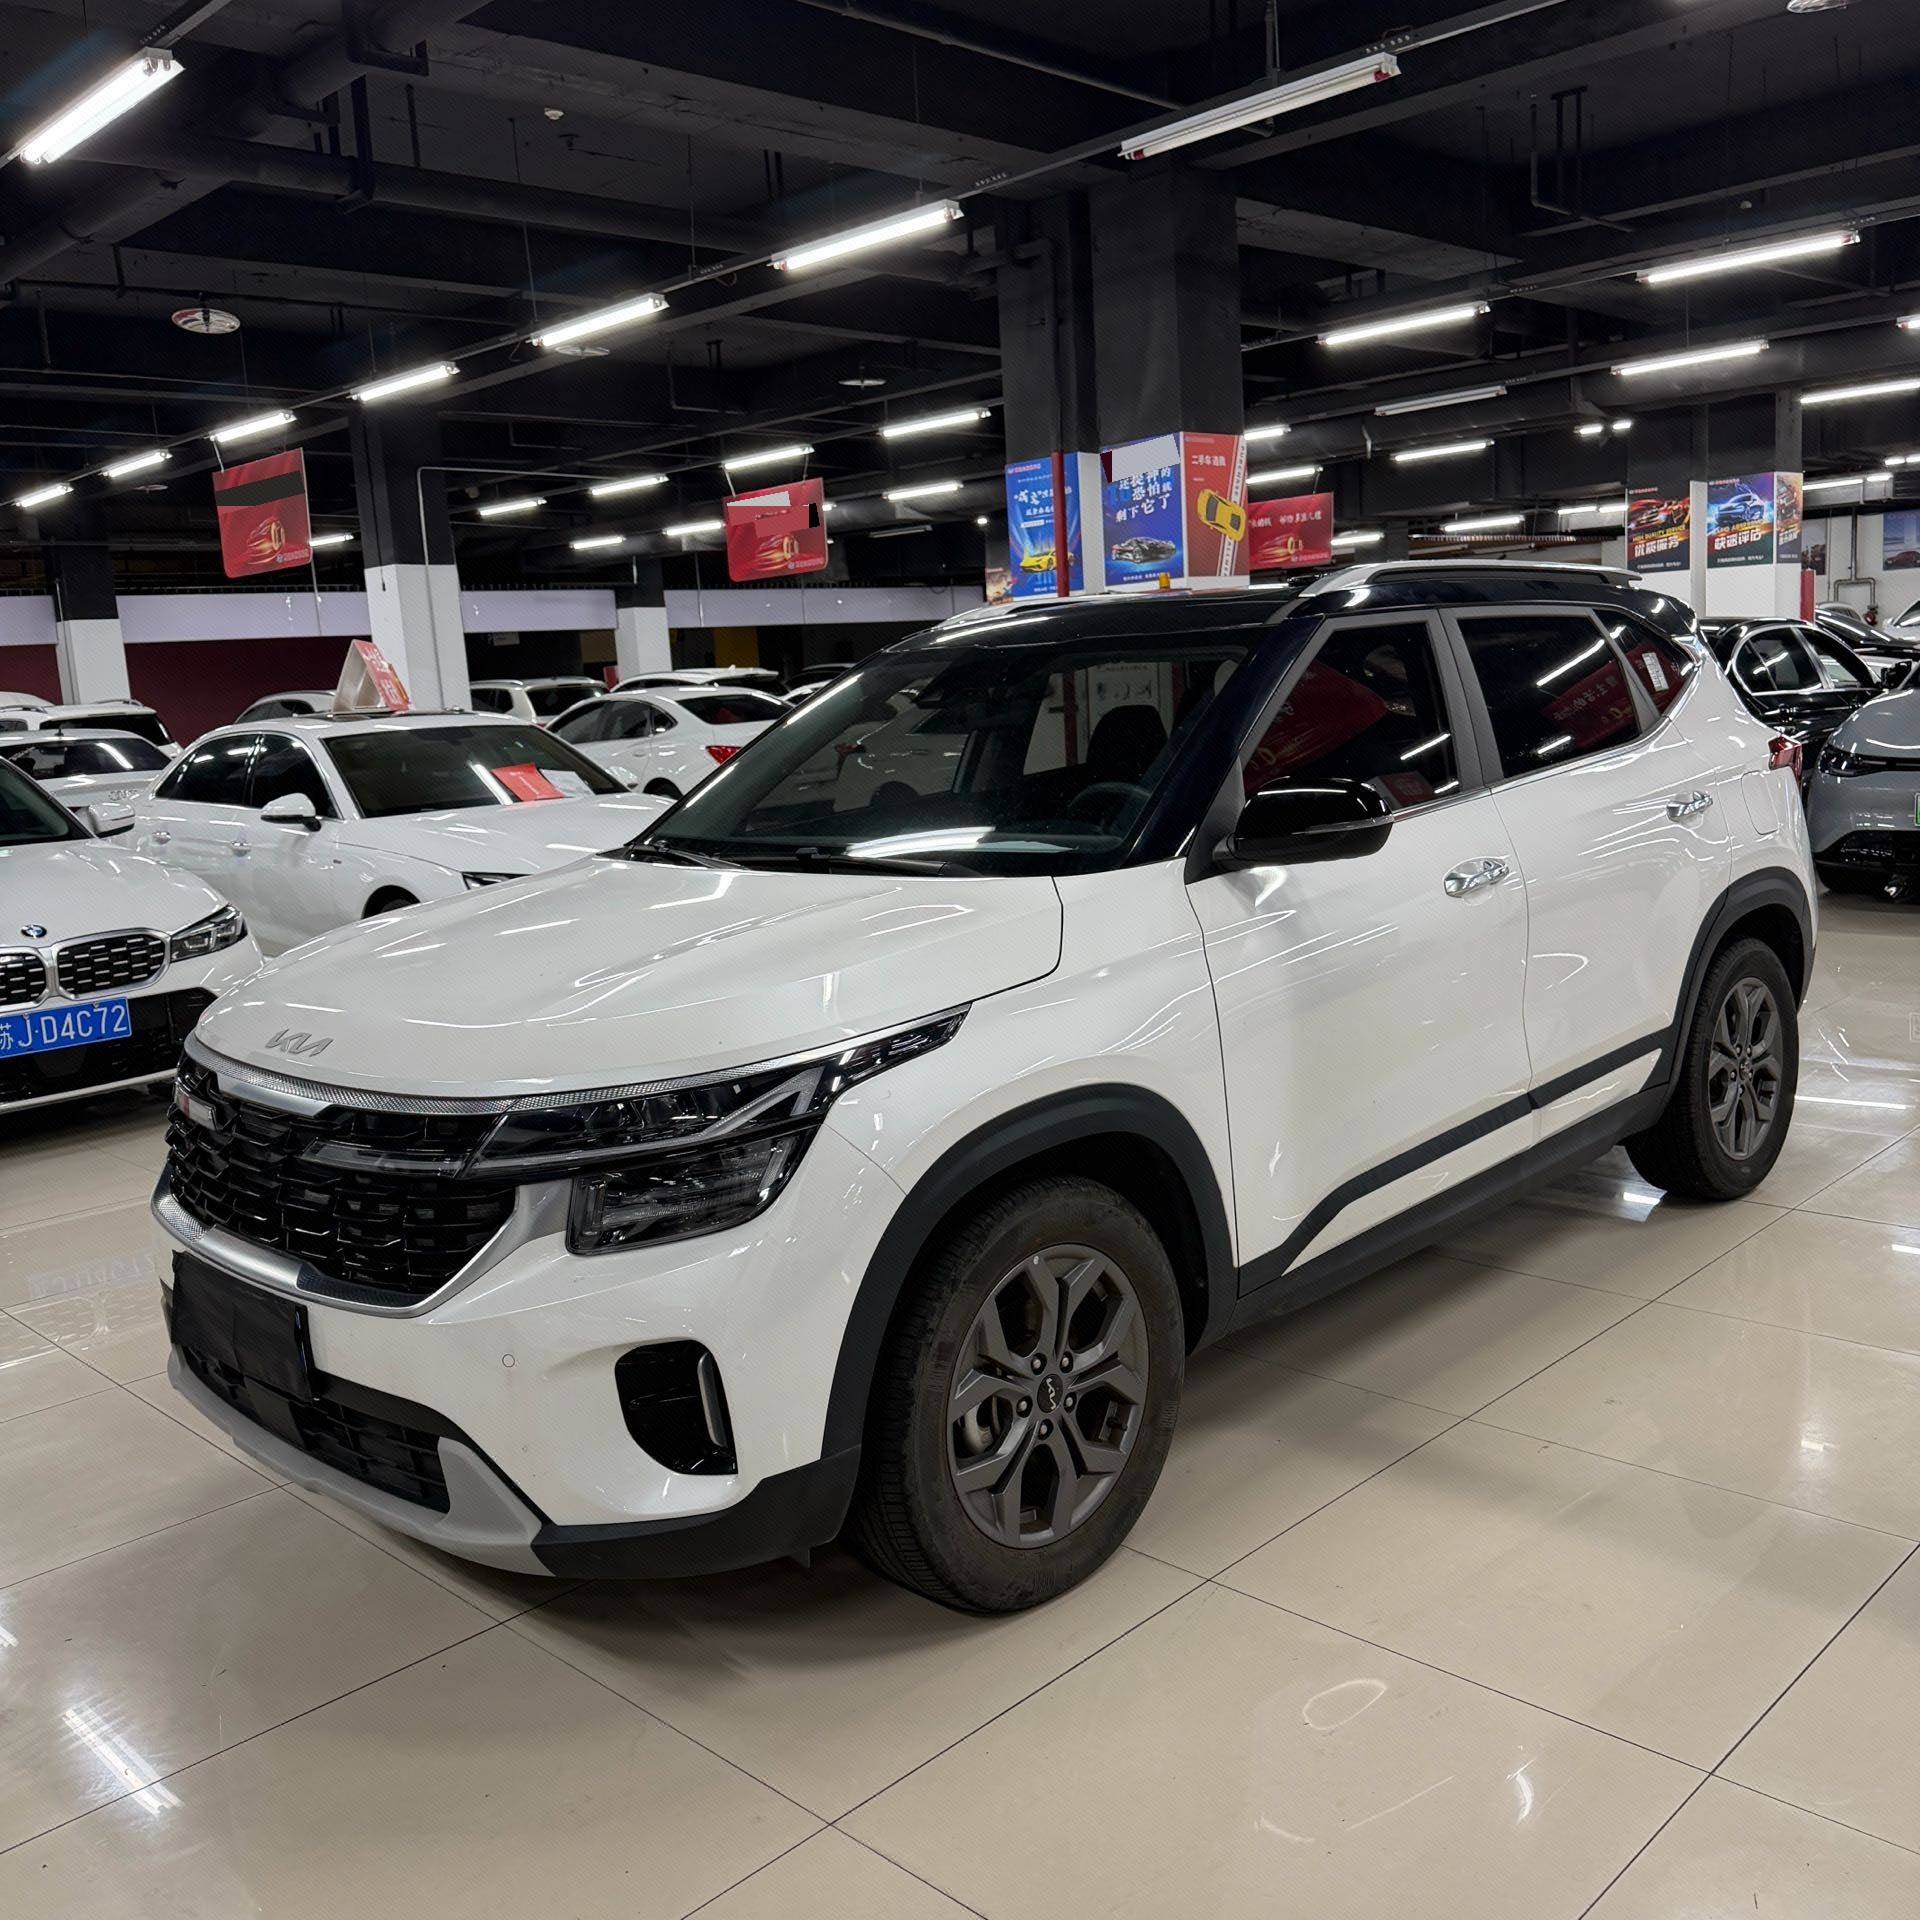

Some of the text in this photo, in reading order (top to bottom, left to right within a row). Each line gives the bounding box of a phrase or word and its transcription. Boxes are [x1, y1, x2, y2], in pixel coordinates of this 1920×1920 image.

[1116, 493, 1170, 522] 剩下它了
[1634, 536, 1679, 557] 优质服务
[1714, 528, 1761, 550] 快速评估
